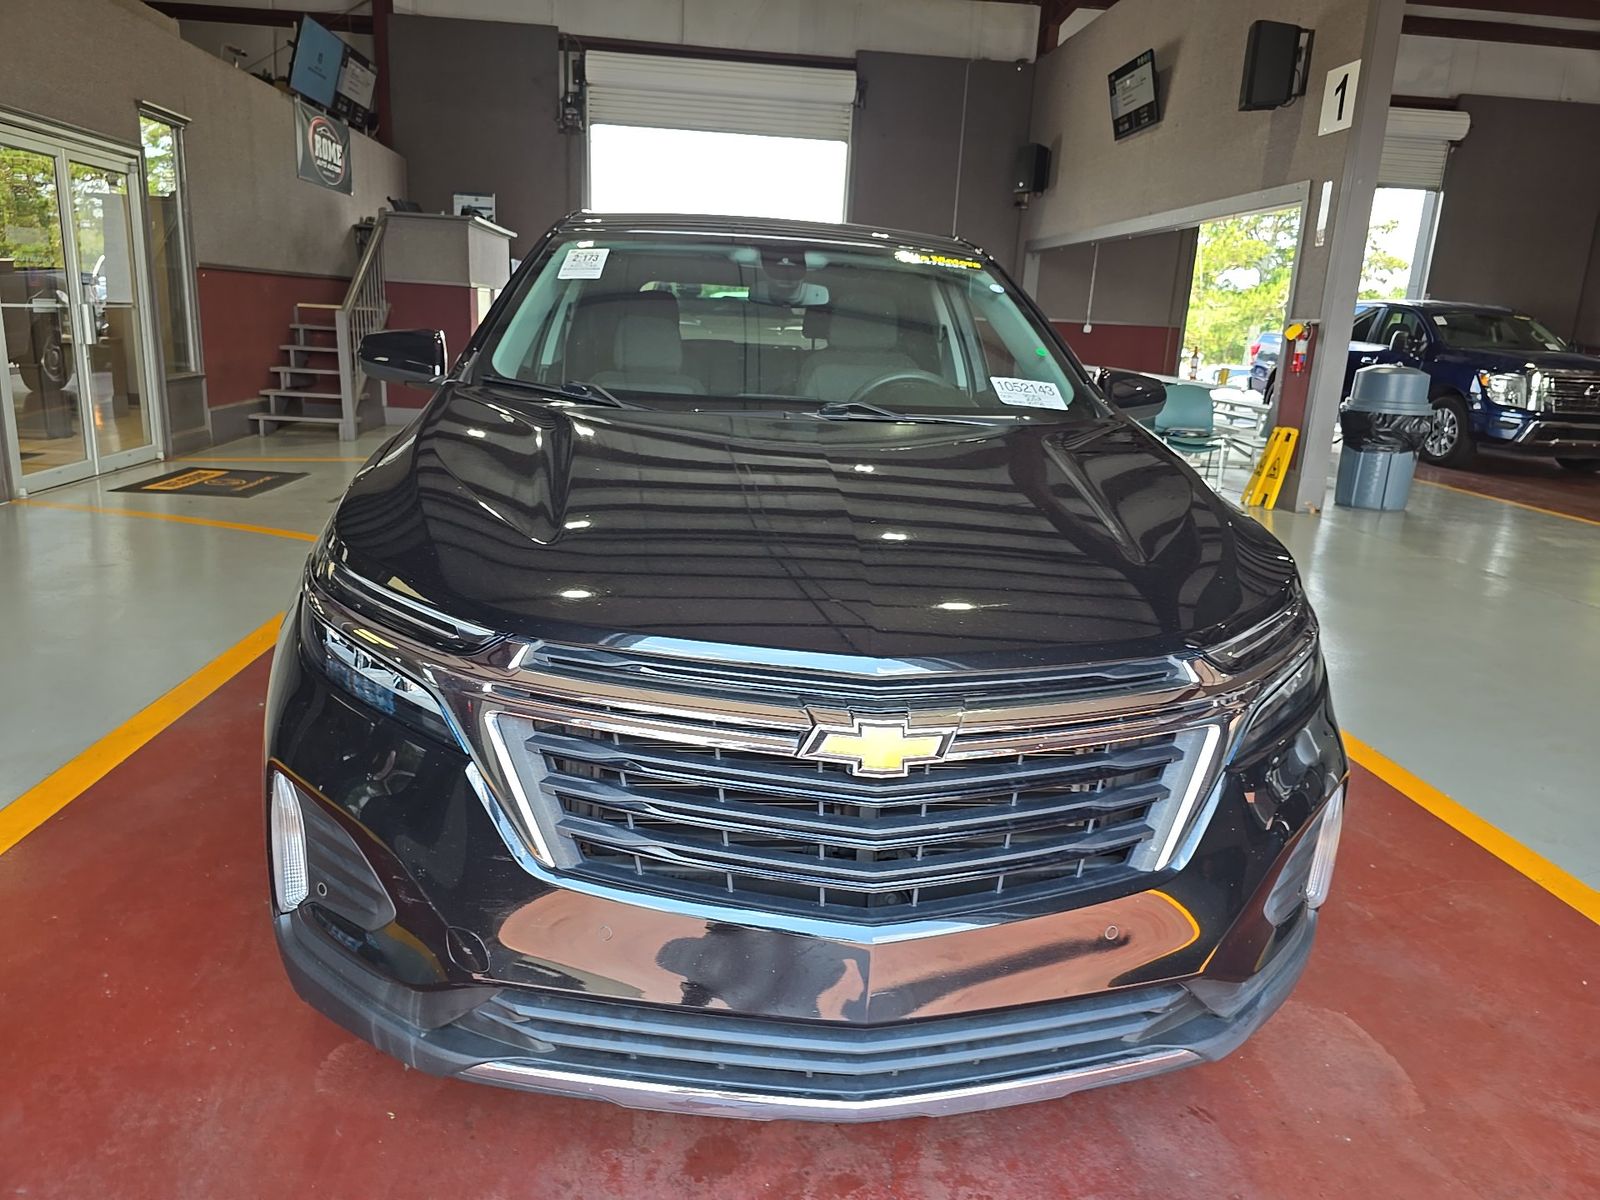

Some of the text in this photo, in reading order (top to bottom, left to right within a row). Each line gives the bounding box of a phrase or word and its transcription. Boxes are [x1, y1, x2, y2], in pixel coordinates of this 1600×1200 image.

[1335, 73, 1349, 121] 1
[314, 134, 343, 167] ROME
[996, 380, 1056, 397] 1052143
